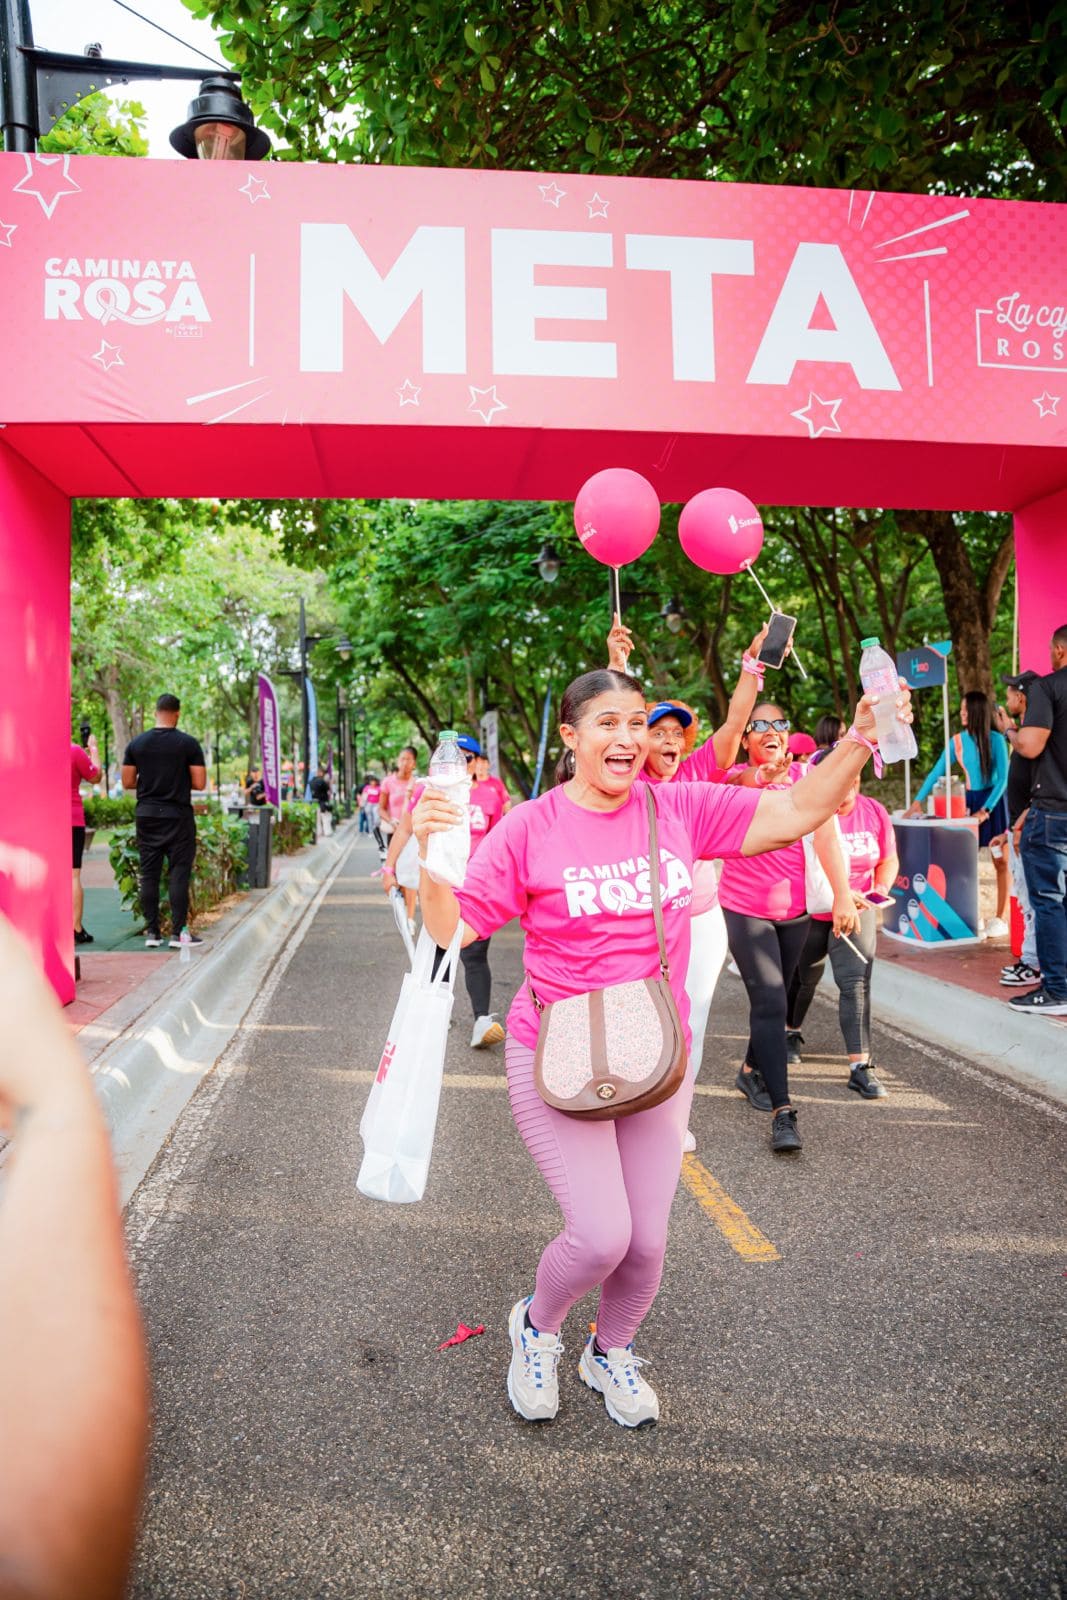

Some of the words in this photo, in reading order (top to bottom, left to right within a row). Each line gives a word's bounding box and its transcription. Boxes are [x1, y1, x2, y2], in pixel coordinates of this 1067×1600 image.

[44, 257, 196, 280] CAMINATA
[44, 278, 212, 326] ROSA
[299, 222, 903, 393] META
[996, 291, 1034, 333] La
[997, 337, 1066, 361] ROS
[562, 847, 677, 882] CAMINAA
[564, 858, 693, 918] ROSA
[671, 893, 693, 910] 202
